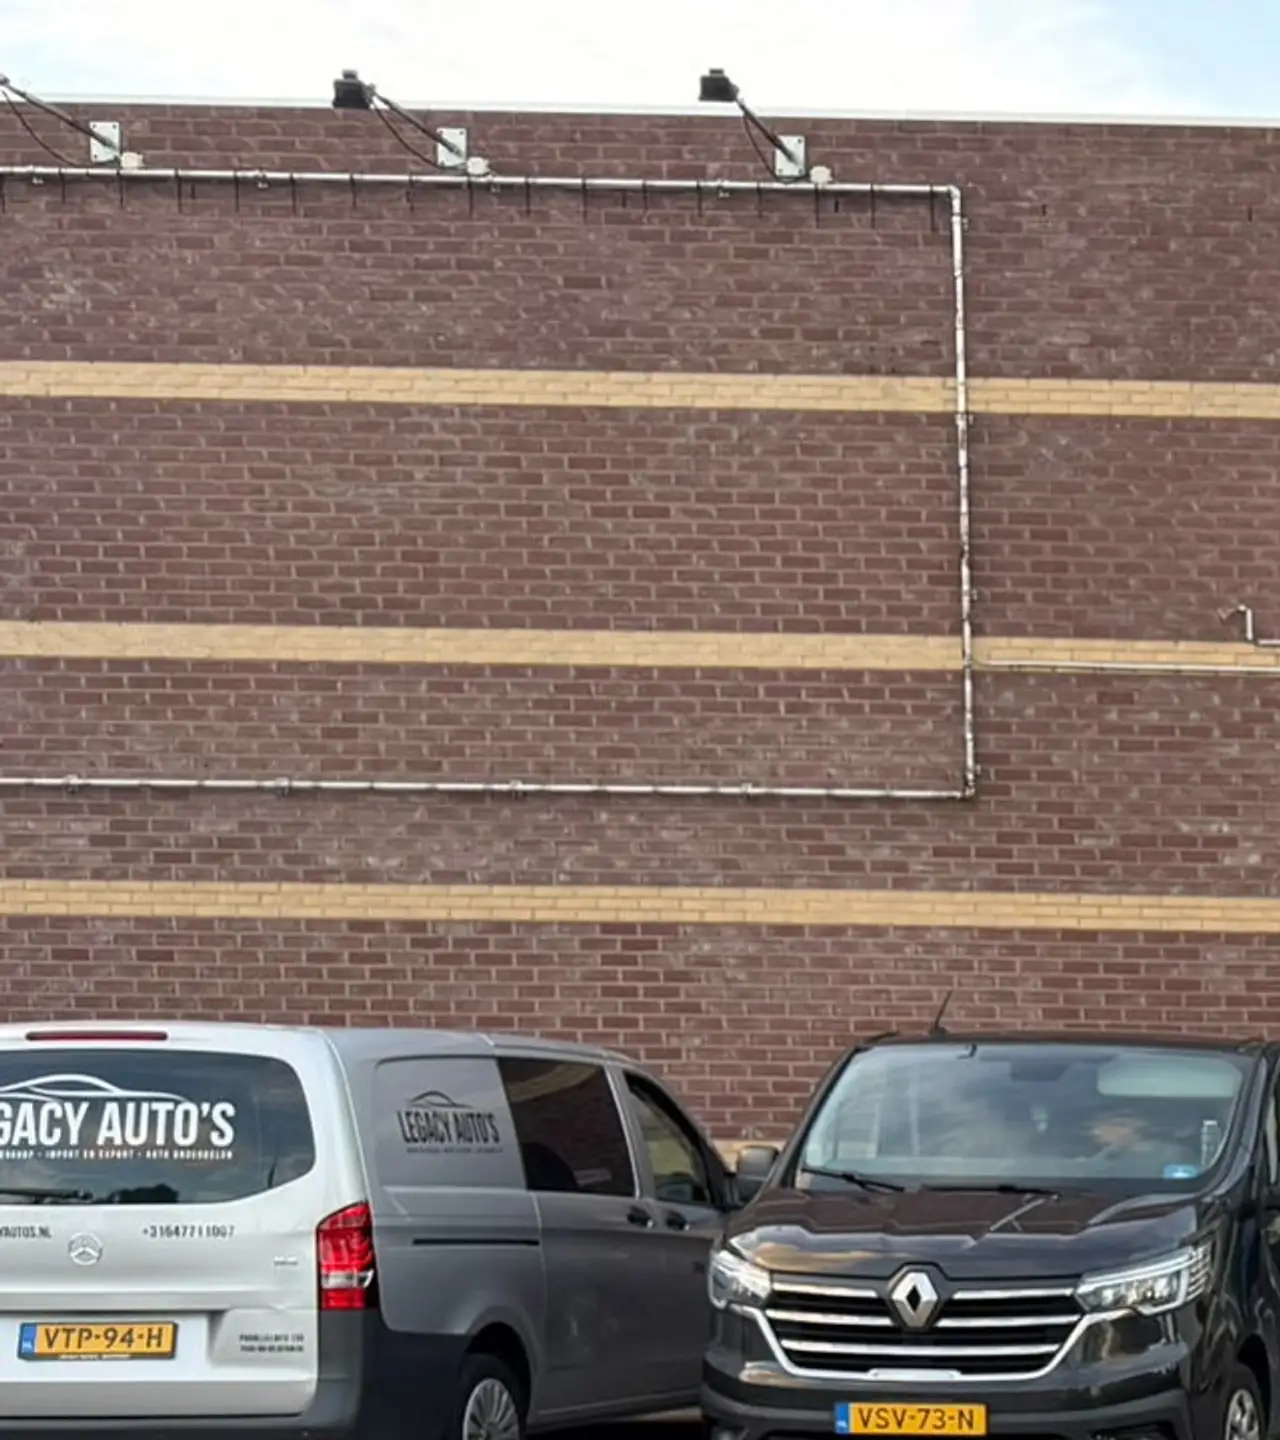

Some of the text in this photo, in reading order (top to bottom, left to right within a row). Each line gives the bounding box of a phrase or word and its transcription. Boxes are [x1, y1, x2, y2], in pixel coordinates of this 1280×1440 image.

[97, 1101, 236, 1147] AUTO'S
[44, 1327, 164, 1350] VTP-94-H
[857, 1407, 975, 1431] VSV-73-N
